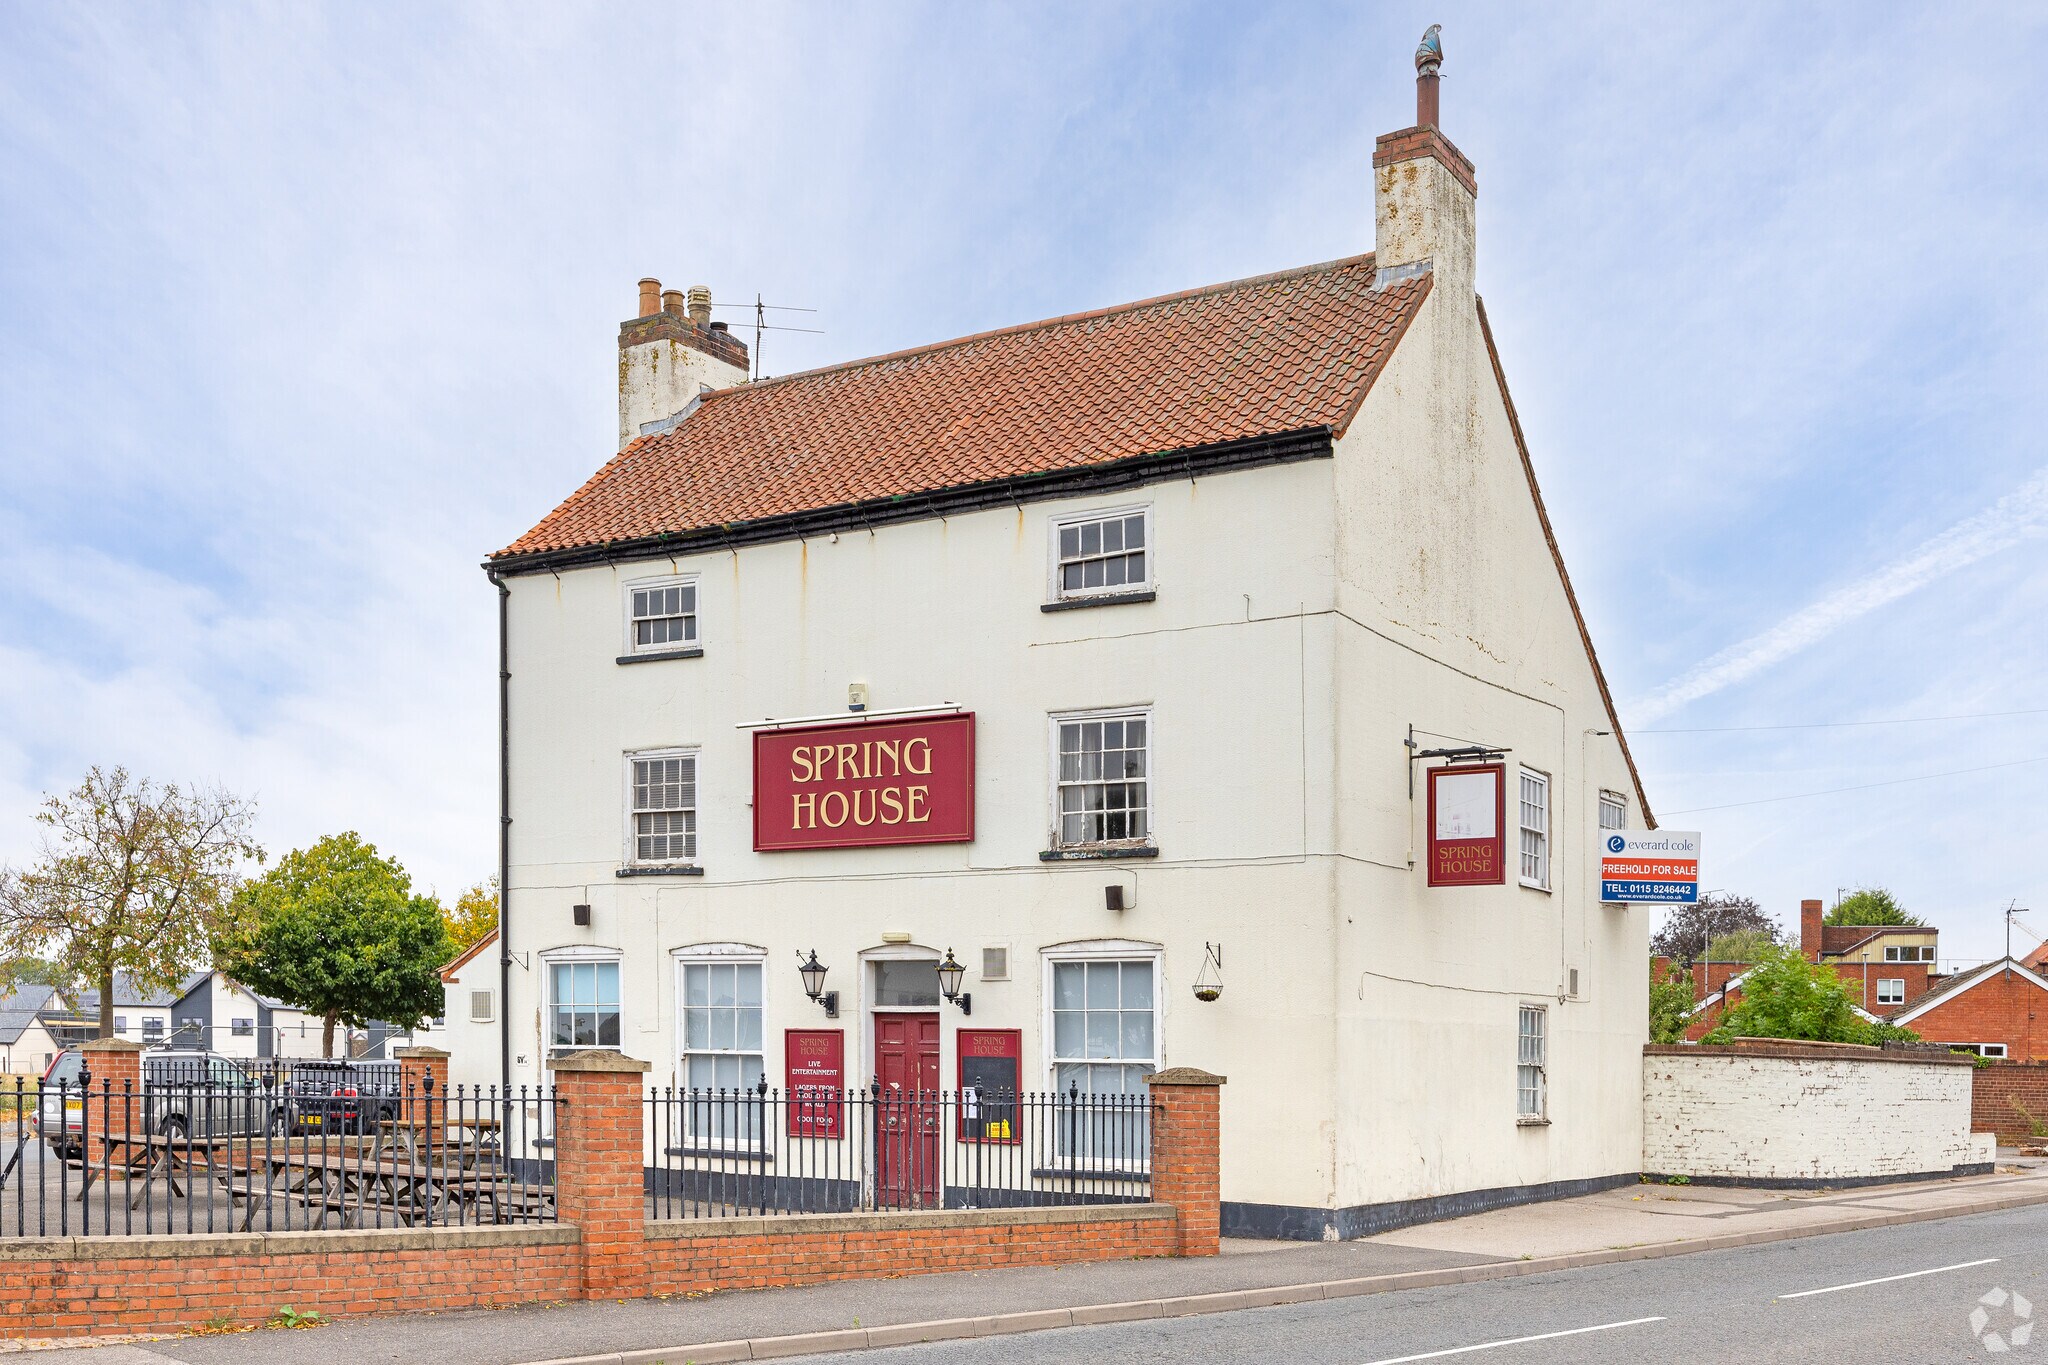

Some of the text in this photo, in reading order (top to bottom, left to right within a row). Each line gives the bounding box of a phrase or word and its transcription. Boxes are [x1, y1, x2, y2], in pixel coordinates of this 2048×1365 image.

[791, 737, 933, 782] SPRING
[791, 785, 932, 830] HOUSE
[1628, 839, 1669, 850] everard
[1671, 839, 1694, 851] cole
[1439, 845, 1492, 859] SPRING
[1440, 860, 1491, 873] HOUSE
[1602, 864, 1696, 876] FREEHOLD FOR SALE
[1606, 883, 1691, 894] TEL: 0115 8246442
[800, 1037, 829, 1046] SPRING
[973, 1036, 1005, 1045] SPRING
[801, 1047, 828, 1055] HOUSE
[974, 1046, 1005, 1055] HOUSE
